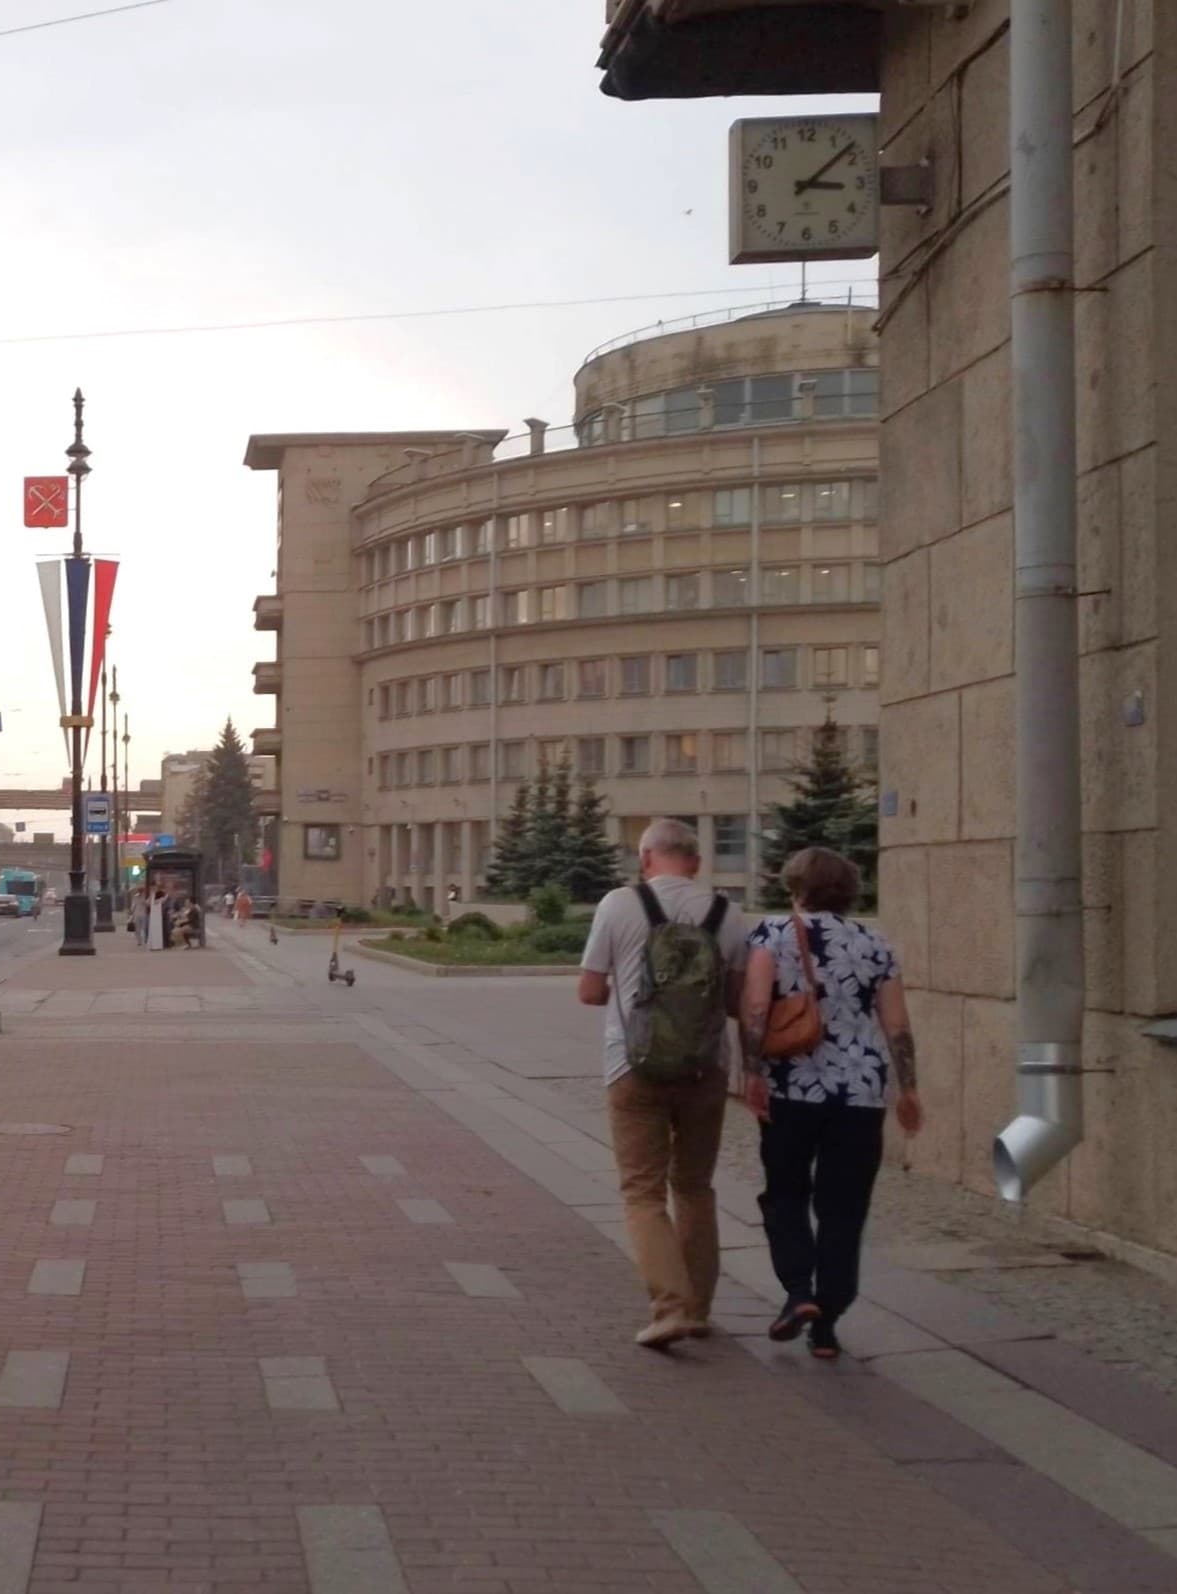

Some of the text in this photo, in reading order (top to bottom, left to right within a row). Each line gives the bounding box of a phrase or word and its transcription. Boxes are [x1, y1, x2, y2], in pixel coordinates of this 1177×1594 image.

[797, 129, 816, 142] 12
[773, 137, 787, 149] 11
[755, 156, 773, 169] 10
[847, 152, 857, 166] 2
[747, 180, 758, 193] 9
[856, 176, 865, 190] 3
[756, 204, 766, 218] 8
[847, 202, 856, 214] 4
[776, 221, 786, 234] 7
[828, 220, 838, 234] 5
[801, 227, 811, 241] 6
